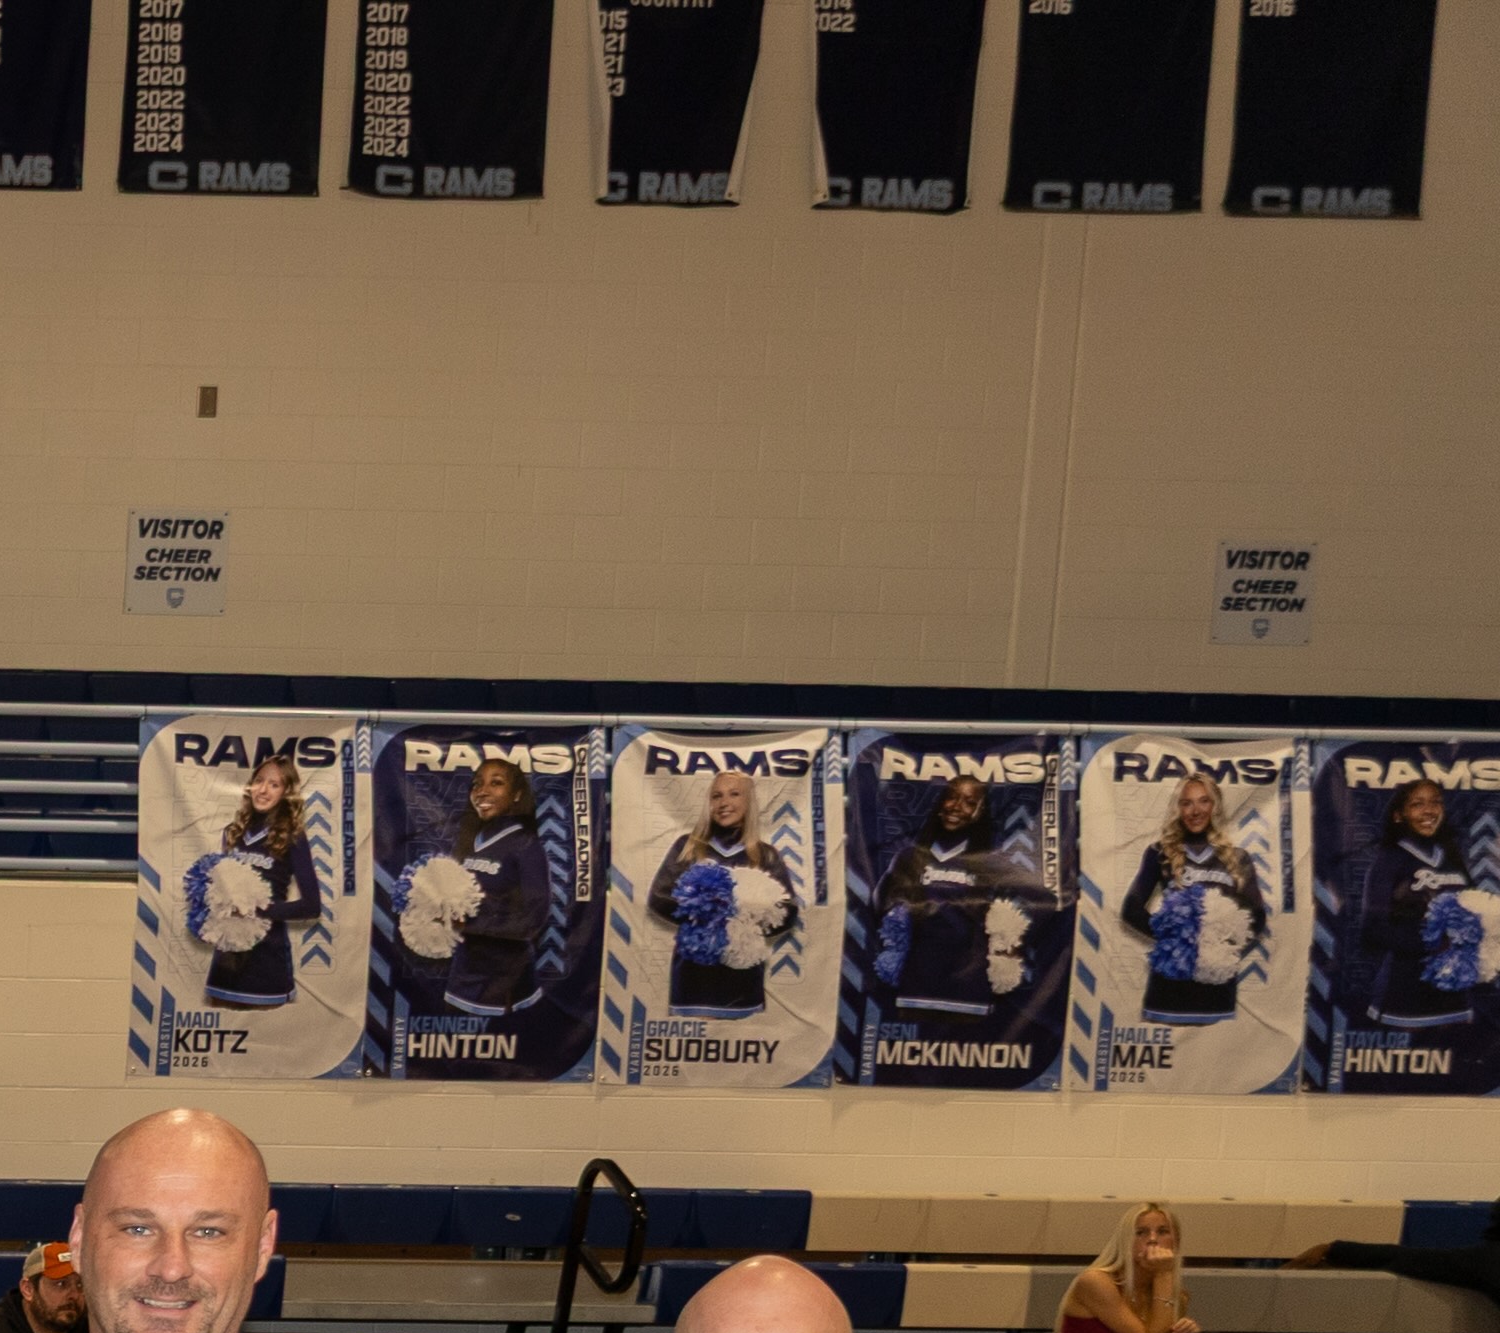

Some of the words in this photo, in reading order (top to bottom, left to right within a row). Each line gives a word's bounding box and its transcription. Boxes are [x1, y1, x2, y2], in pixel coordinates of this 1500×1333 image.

[138, 519, 224, 541] VISITOR
[145, 548, 212, 566] CHEER
[1226, 550, 1310, 570] VISITOR
[134, 566, 220, 583] SECTION
[1232, 580, 1297, 594] CHEER
[1220, 597, 1306, 612] SECTION
[174, 734, 336, 769] RAMS
[405, 741, 575, 774] RAMS
[880, 748, 1044, 783] RAMS
[576, 747, 590, 899] CHEERLEADING
[176, 1012, 219, 1028] MADI
[409, 1016, 489, 1033] KENNEDY
[647, 1021, 707, 1038] GRACIE
[157, 1012, 172, 1068] VARSITY
[879, 1024, 918, 1040] SENI
[1114, 1028, 1172, 1044] HAILEE
[1347, 1032, 1411, 1048] TAYLOR
[174, 1030, 248, 1055] KOTZ
[408, 1034, 517, 1059] HINTON
[644, 1039, 780, 1064] SUDBURY
[173, 1056, 209, 1068] 2026
[877, 1041, 1032, 1069] MCKINNON
[1111, 1046, 1174, 1069] MAE
[1344, 1049, 1450, 1074] HINTON
[643, 1065, 680, 1077] 2026
